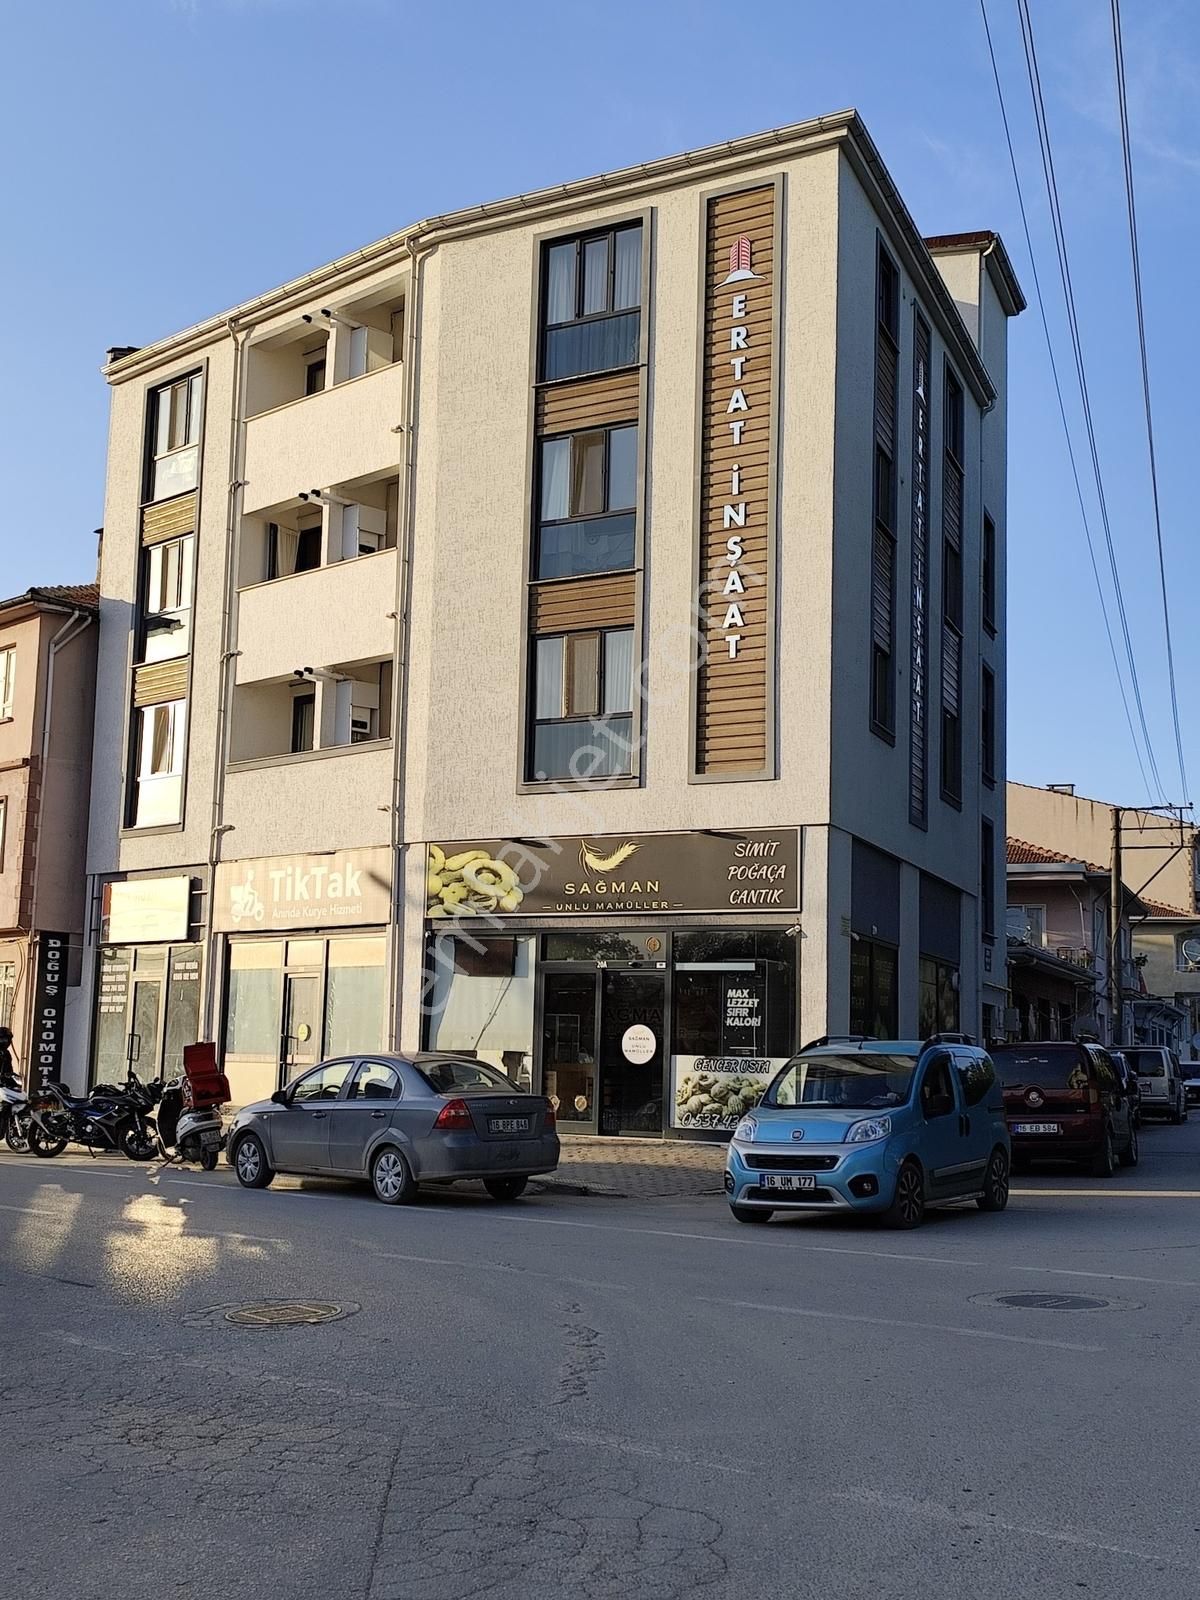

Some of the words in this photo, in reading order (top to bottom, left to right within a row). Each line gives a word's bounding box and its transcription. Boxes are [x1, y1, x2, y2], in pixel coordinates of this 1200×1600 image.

[726, 294, 749, 446] ERTAT
[721, 463, 747, 660] İNŞAAT
[734, 839, 780, 857] SİMİT
[727, 863, 787, 883] POĞAÇA
[269, 862, 363, 902] TikTak
[564, 880, 660, 895] SAĞMAN
[730, 888, 784, 904] CANTIK
[302, 905, 328, 920] Kurye
[329, 902, 362, 916] Hizmeti
[556, 903, 590, 911] UNLU
[726, 989, 750, 998] MAX
[726, 999, 760, 1008] LEZZET
[726, 1008, 749, 1017] SIFIR
[726, 1015, 762, 1027] KALORİ
[739, 1059, 771, 1074] USTA
[681, 1112, 692, 1127] 0
[694, 1112, 721, 1128] 537
[766, 1176, 776, 1186] 16
[797, 1176, 814, 1187] 177
